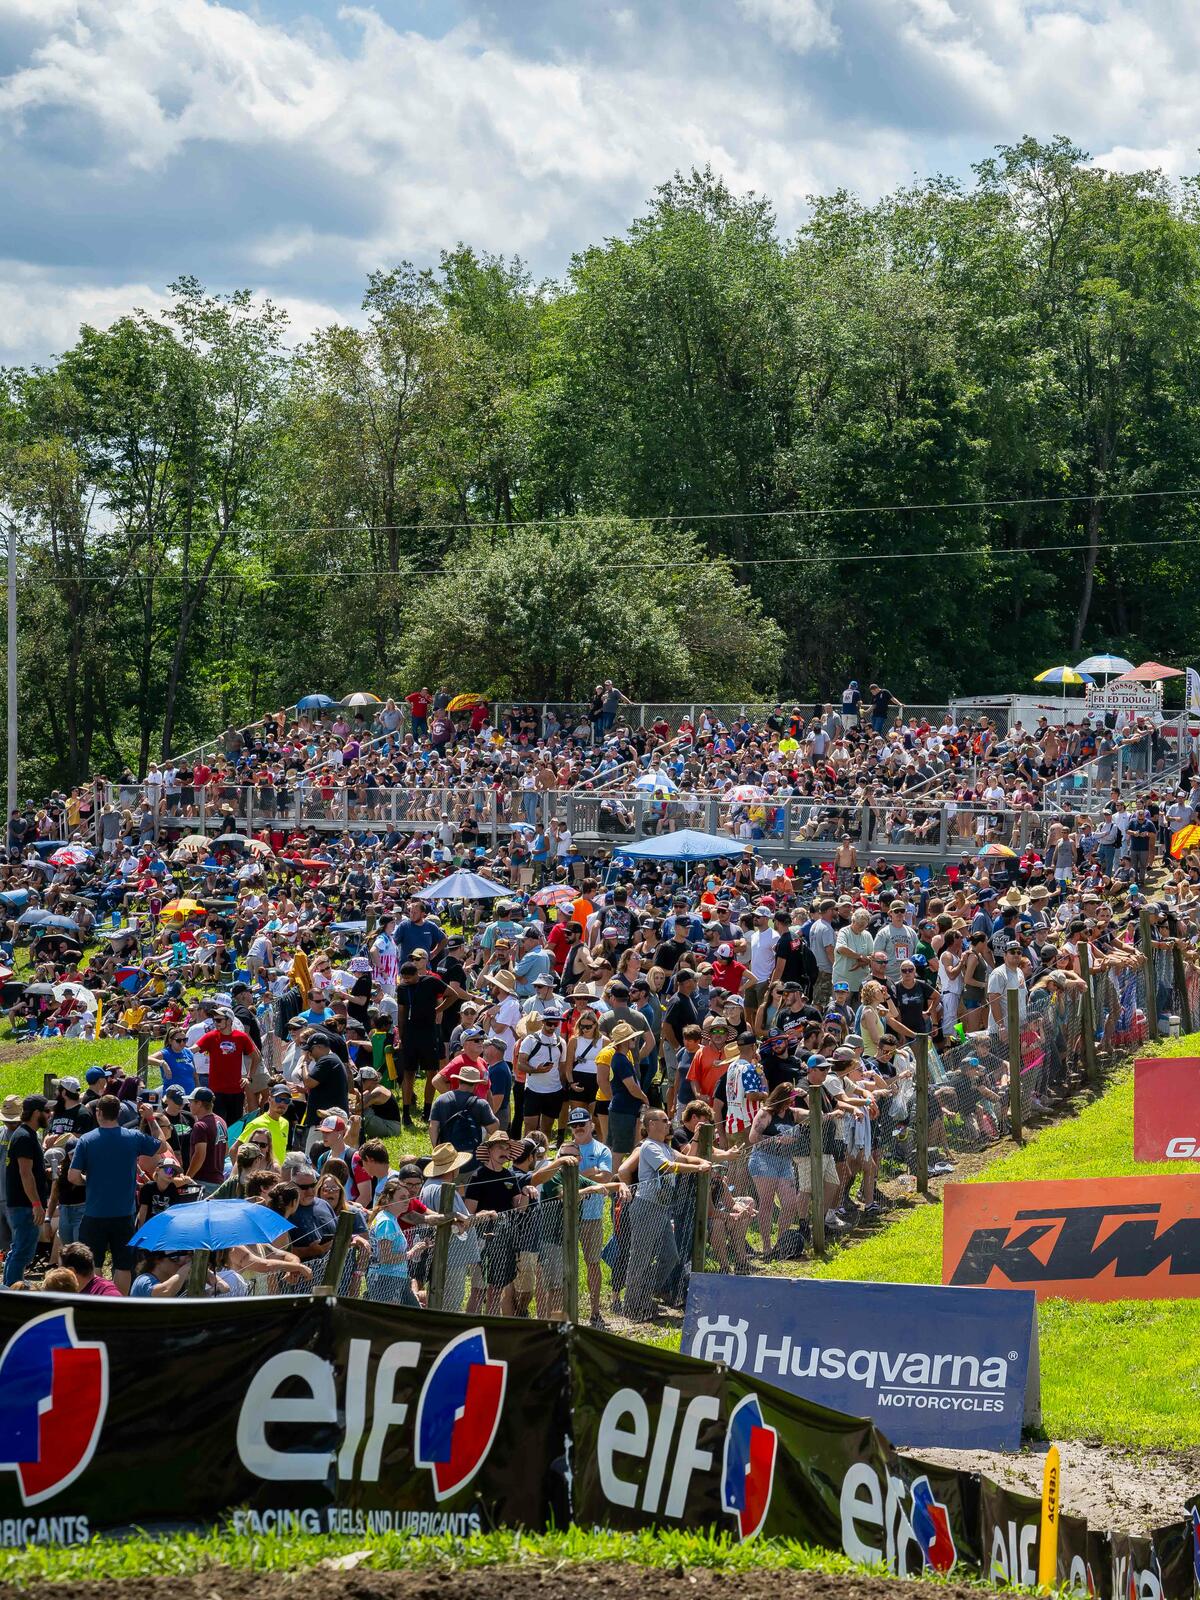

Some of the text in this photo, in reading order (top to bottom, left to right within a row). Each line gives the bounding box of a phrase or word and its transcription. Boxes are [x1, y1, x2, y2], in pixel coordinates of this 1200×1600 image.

[1093, 695, 1119, 704] FRED
[236, 1338, 422, 1482] elf
[877, 1392, 1006, 1413] MOTORCYCLES
[597, 1386, 720, 1519] elf
[1048, 1466, 1056, 1524] ACERBIS
[366, 1510, 393, 1534] AND
